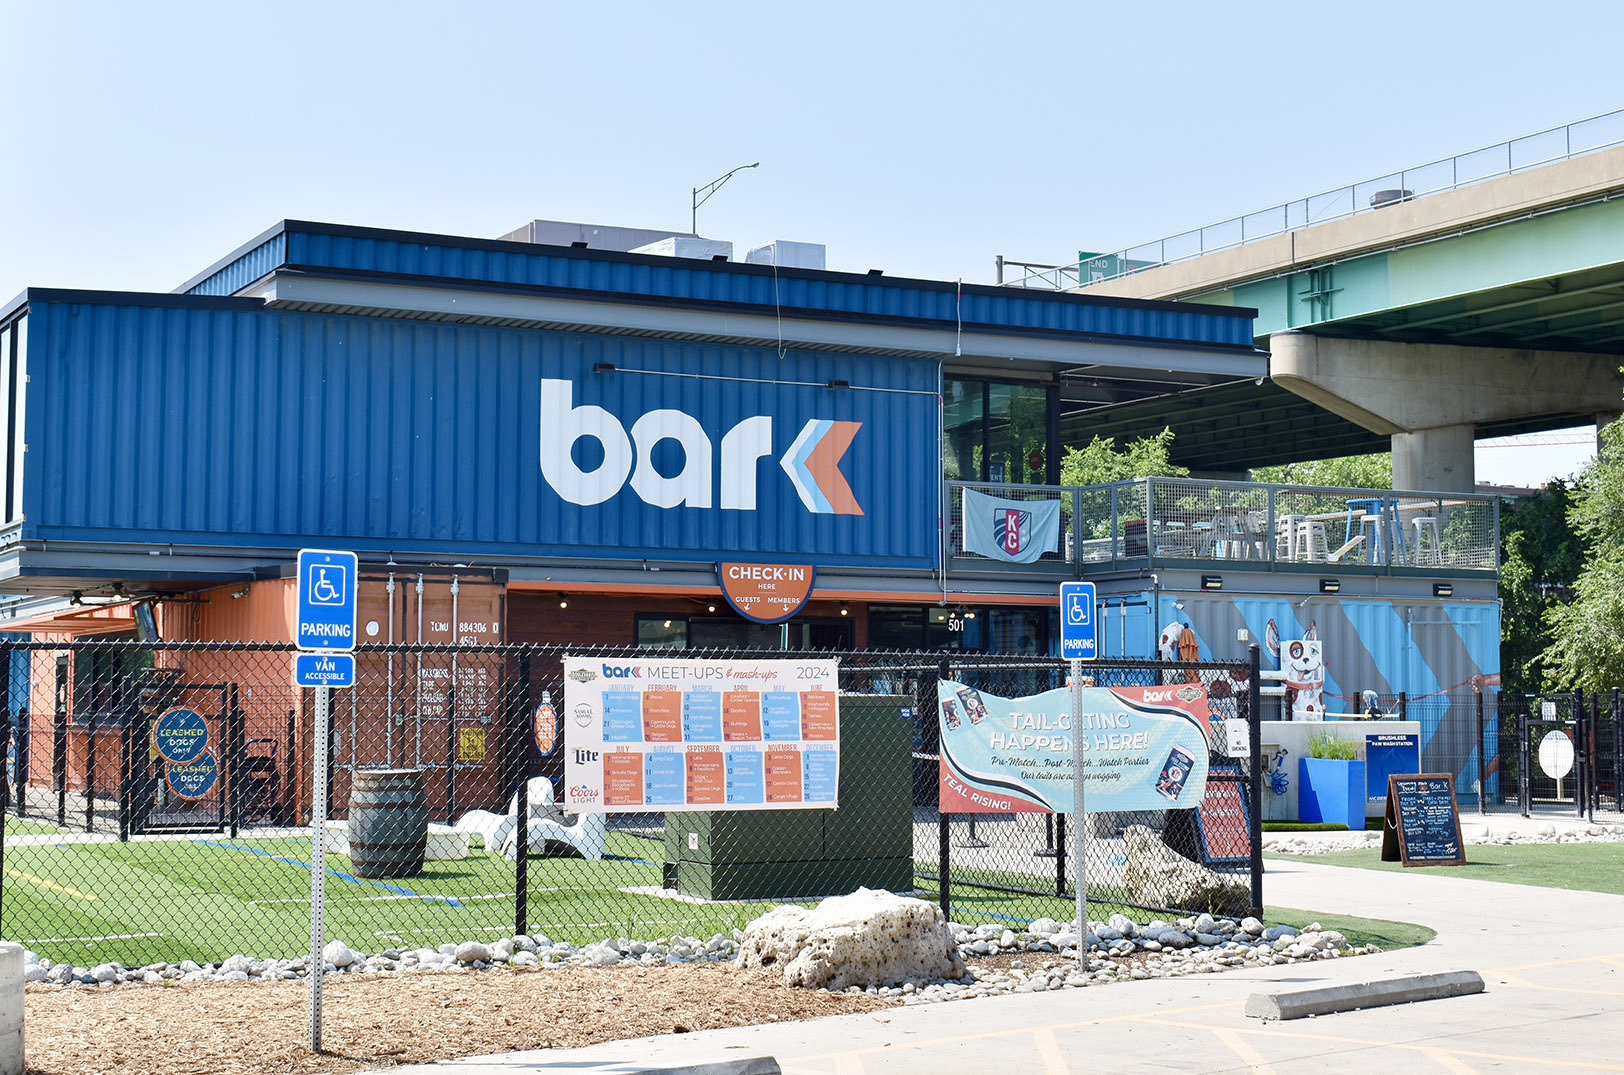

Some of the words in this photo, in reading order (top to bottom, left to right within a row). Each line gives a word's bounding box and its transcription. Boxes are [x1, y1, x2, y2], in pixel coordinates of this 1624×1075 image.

[301, 622, 351, 637] PARKING
[459, 622, 487, 633] 884306
[948, 619, 965, 632] 501
[1064, 638, 1095, 650] PARKING
[315, 661, 336, 672] VAN
[304, 672, 345, 680] ACCESSIBLE
[647, 666, 724, 679] MEET-UPS
[733, 666, 778, 682] mash-ups
[796, 666, 830, 679] 2024
[648, 684, 677, 692] FEBRUARY
[1010, 712, 1131, 731] TAIL-GTING
[160, 728, 205, 737] LEASHED
[1094, 733, 1150, 750] HERE!
[616, 745, 629, 753] JULY
[654, 745, 674, 753] AUGUST
[768, 744, 798, 752] NOVEMBER
[806, 744, 834, 752] DECEMBER
[575, 749, 599, 765] Lite
[1123, 756, 1150, 766] Parties
[1035, 771, 1052, 780] tails
[1066, 772, 1092, 781] alys
[1092, 772, 1121, 782] wagging
[570, 785, 599, 797] Coors
[1443, 781, 1448, 790] K
[943, 773, 968, 798] TEAL
[970, 792, 1012, 810] RISING!
